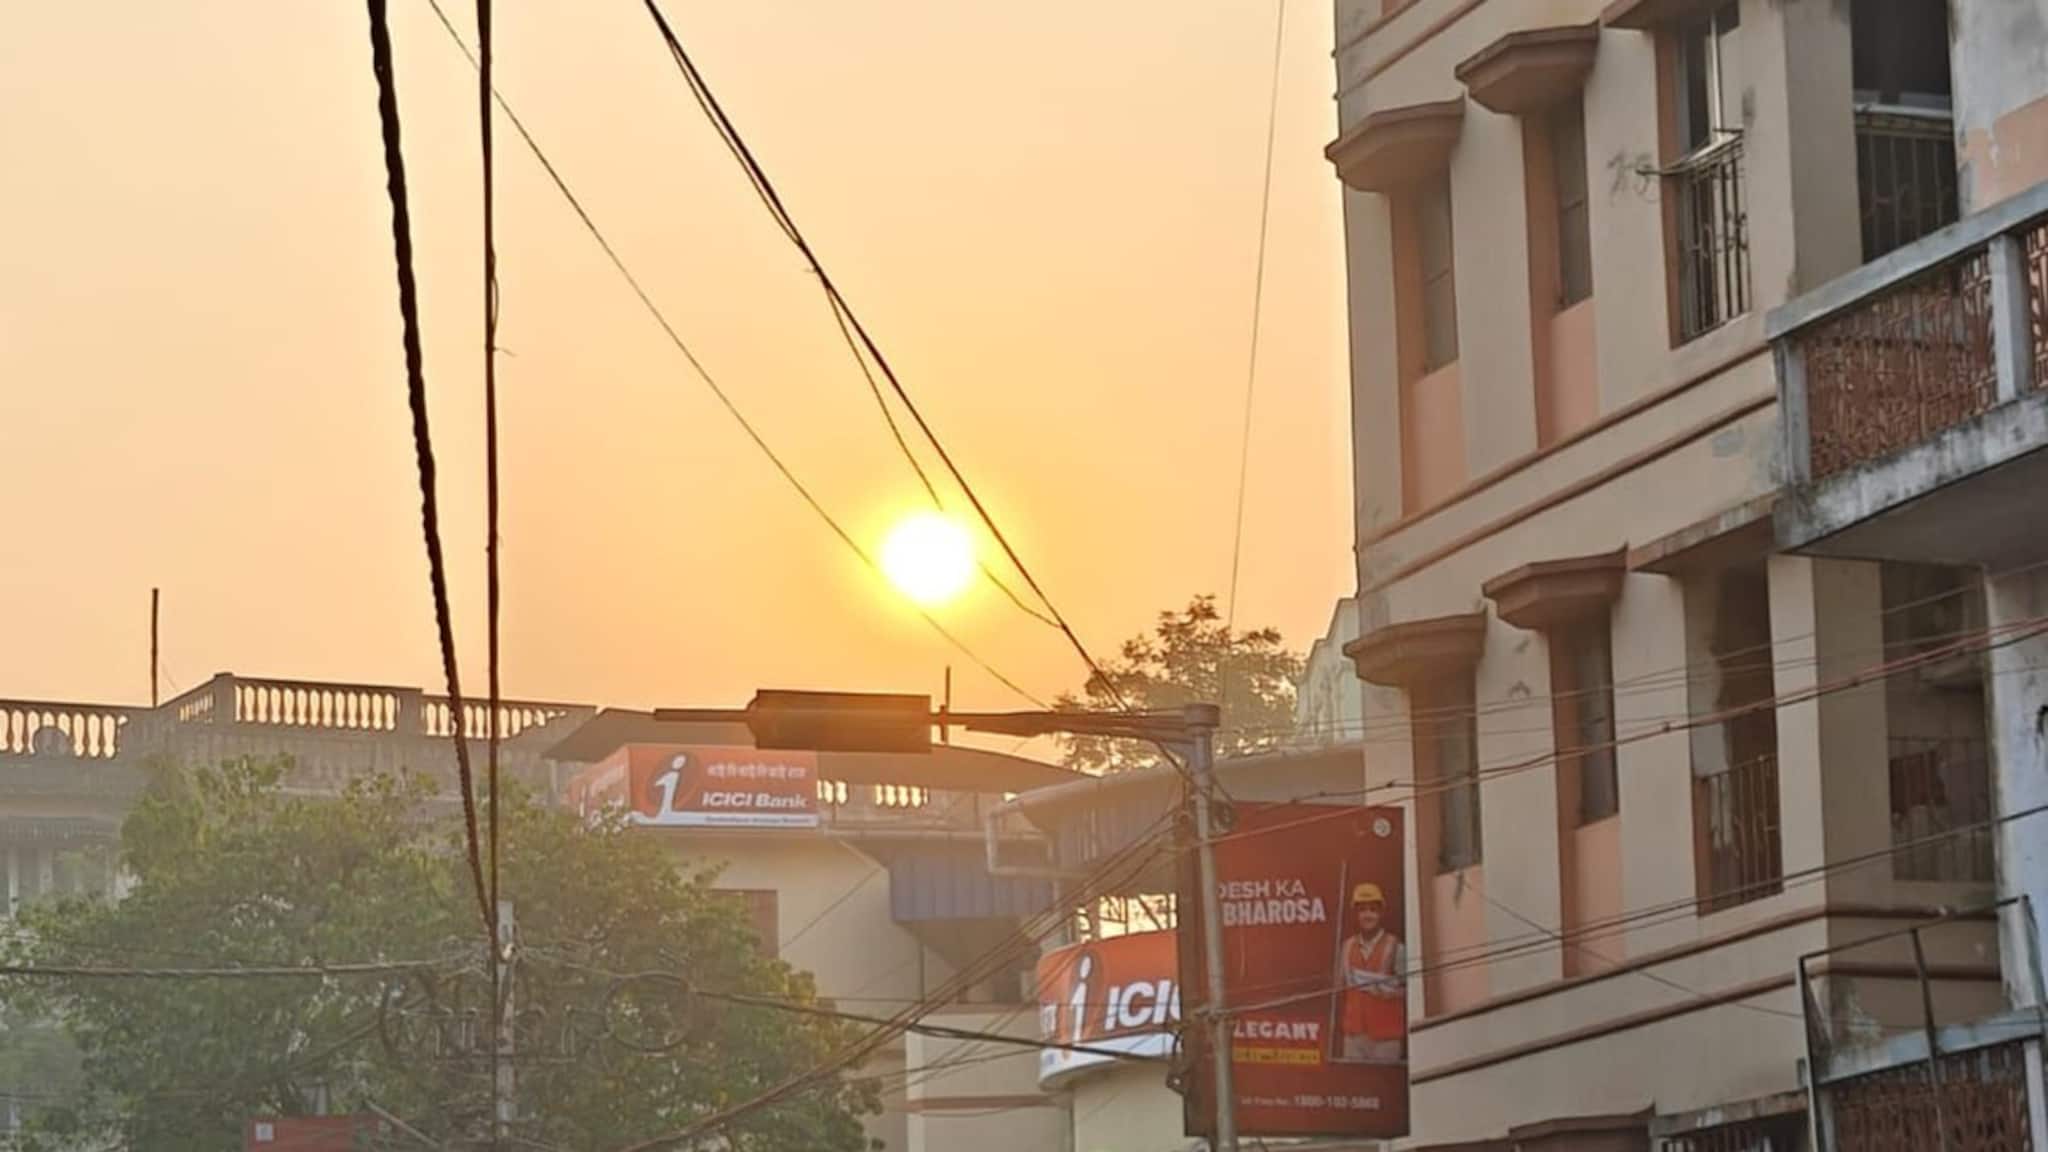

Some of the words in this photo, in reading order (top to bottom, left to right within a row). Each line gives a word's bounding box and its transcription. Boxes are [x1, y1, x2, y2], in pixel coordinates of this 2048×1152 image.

[702, 791, 752, 807] ICICI
[755, 792, 808, 808] Bank
[1275, 879, 1306, 897] KA
[1223, 897, 1326, 927] BHAROSA
